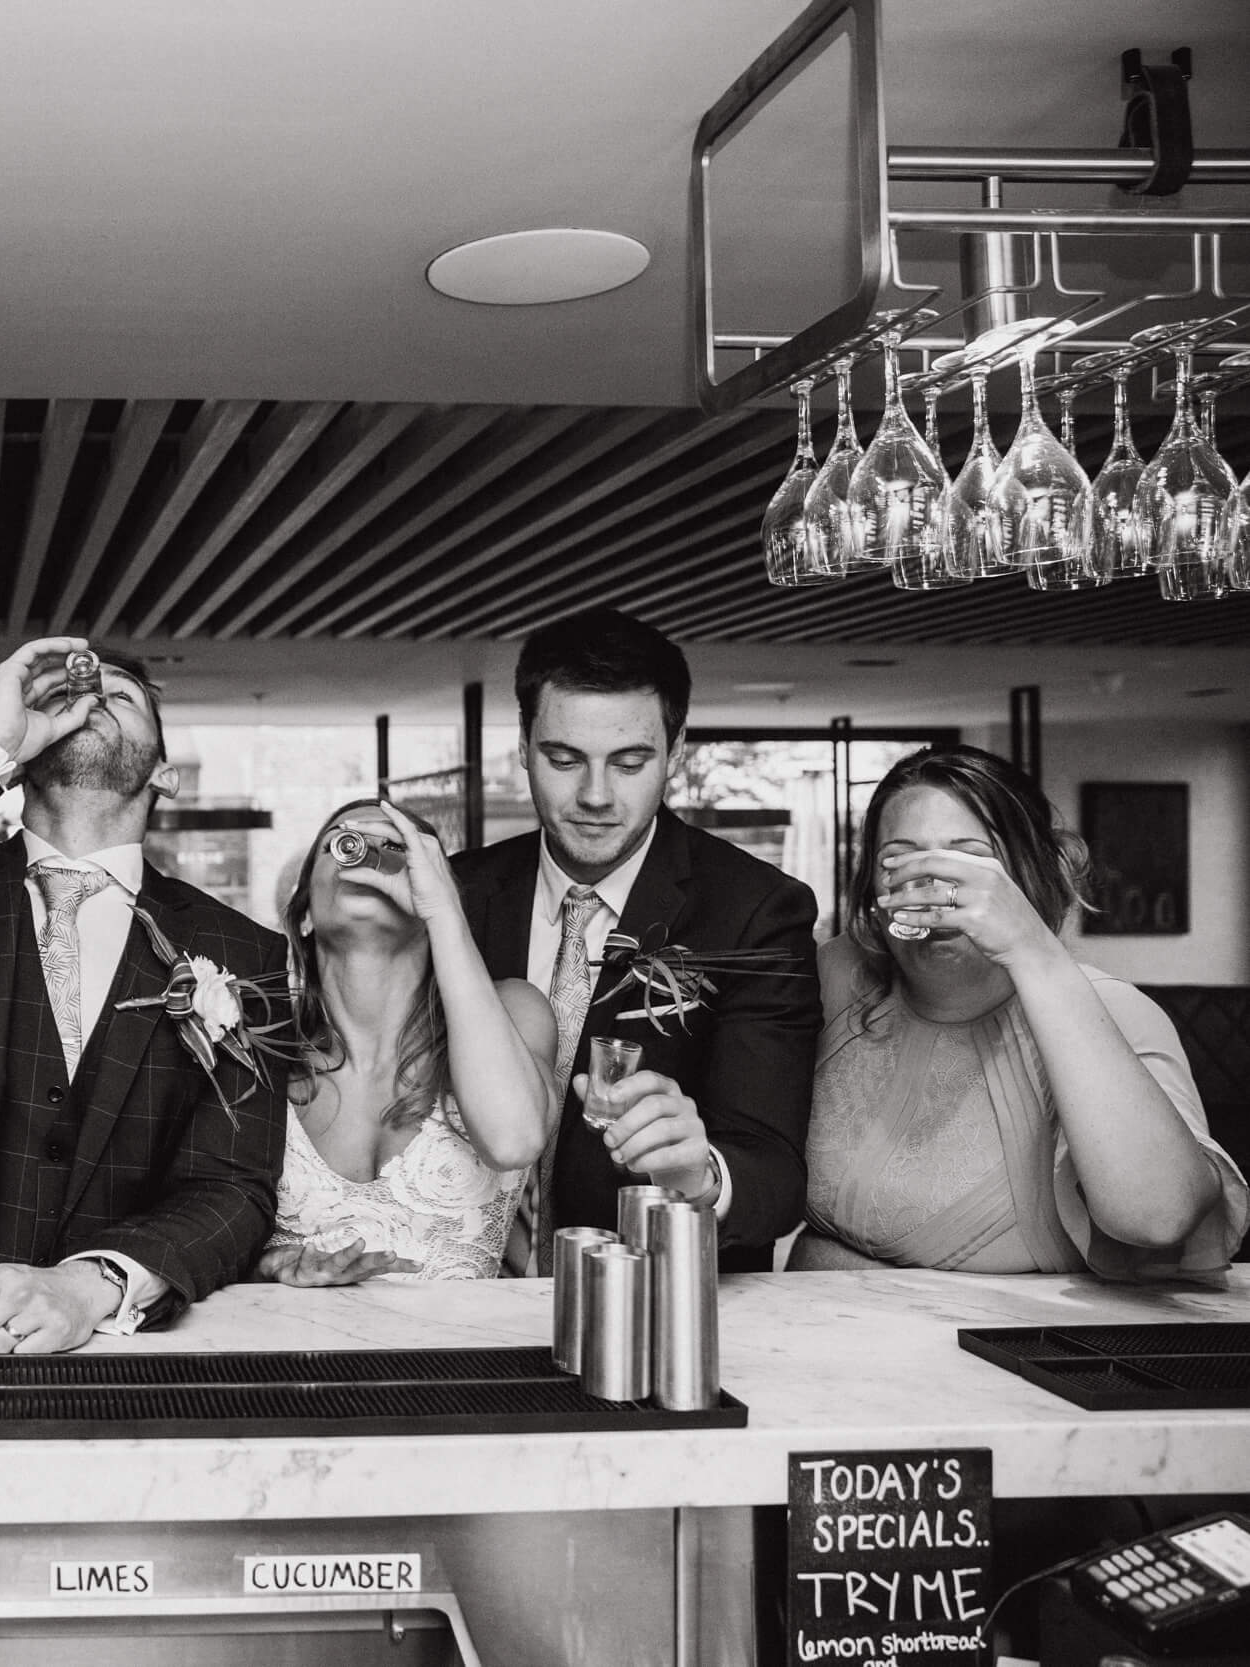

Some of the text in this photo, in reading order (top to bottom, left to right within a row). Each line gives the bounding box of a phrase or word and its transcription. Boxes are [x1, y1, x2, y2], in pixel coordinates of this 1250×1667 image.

[799, 1458, 962, 1504] TODAY'S
[57, 1565, 149, 1592] LIMES
[251, 1561, 415, 1590] CUCUMBER
[796, 1567, 985, 1621] TRY ME
[797, 1630, 875, 1661] lemon
